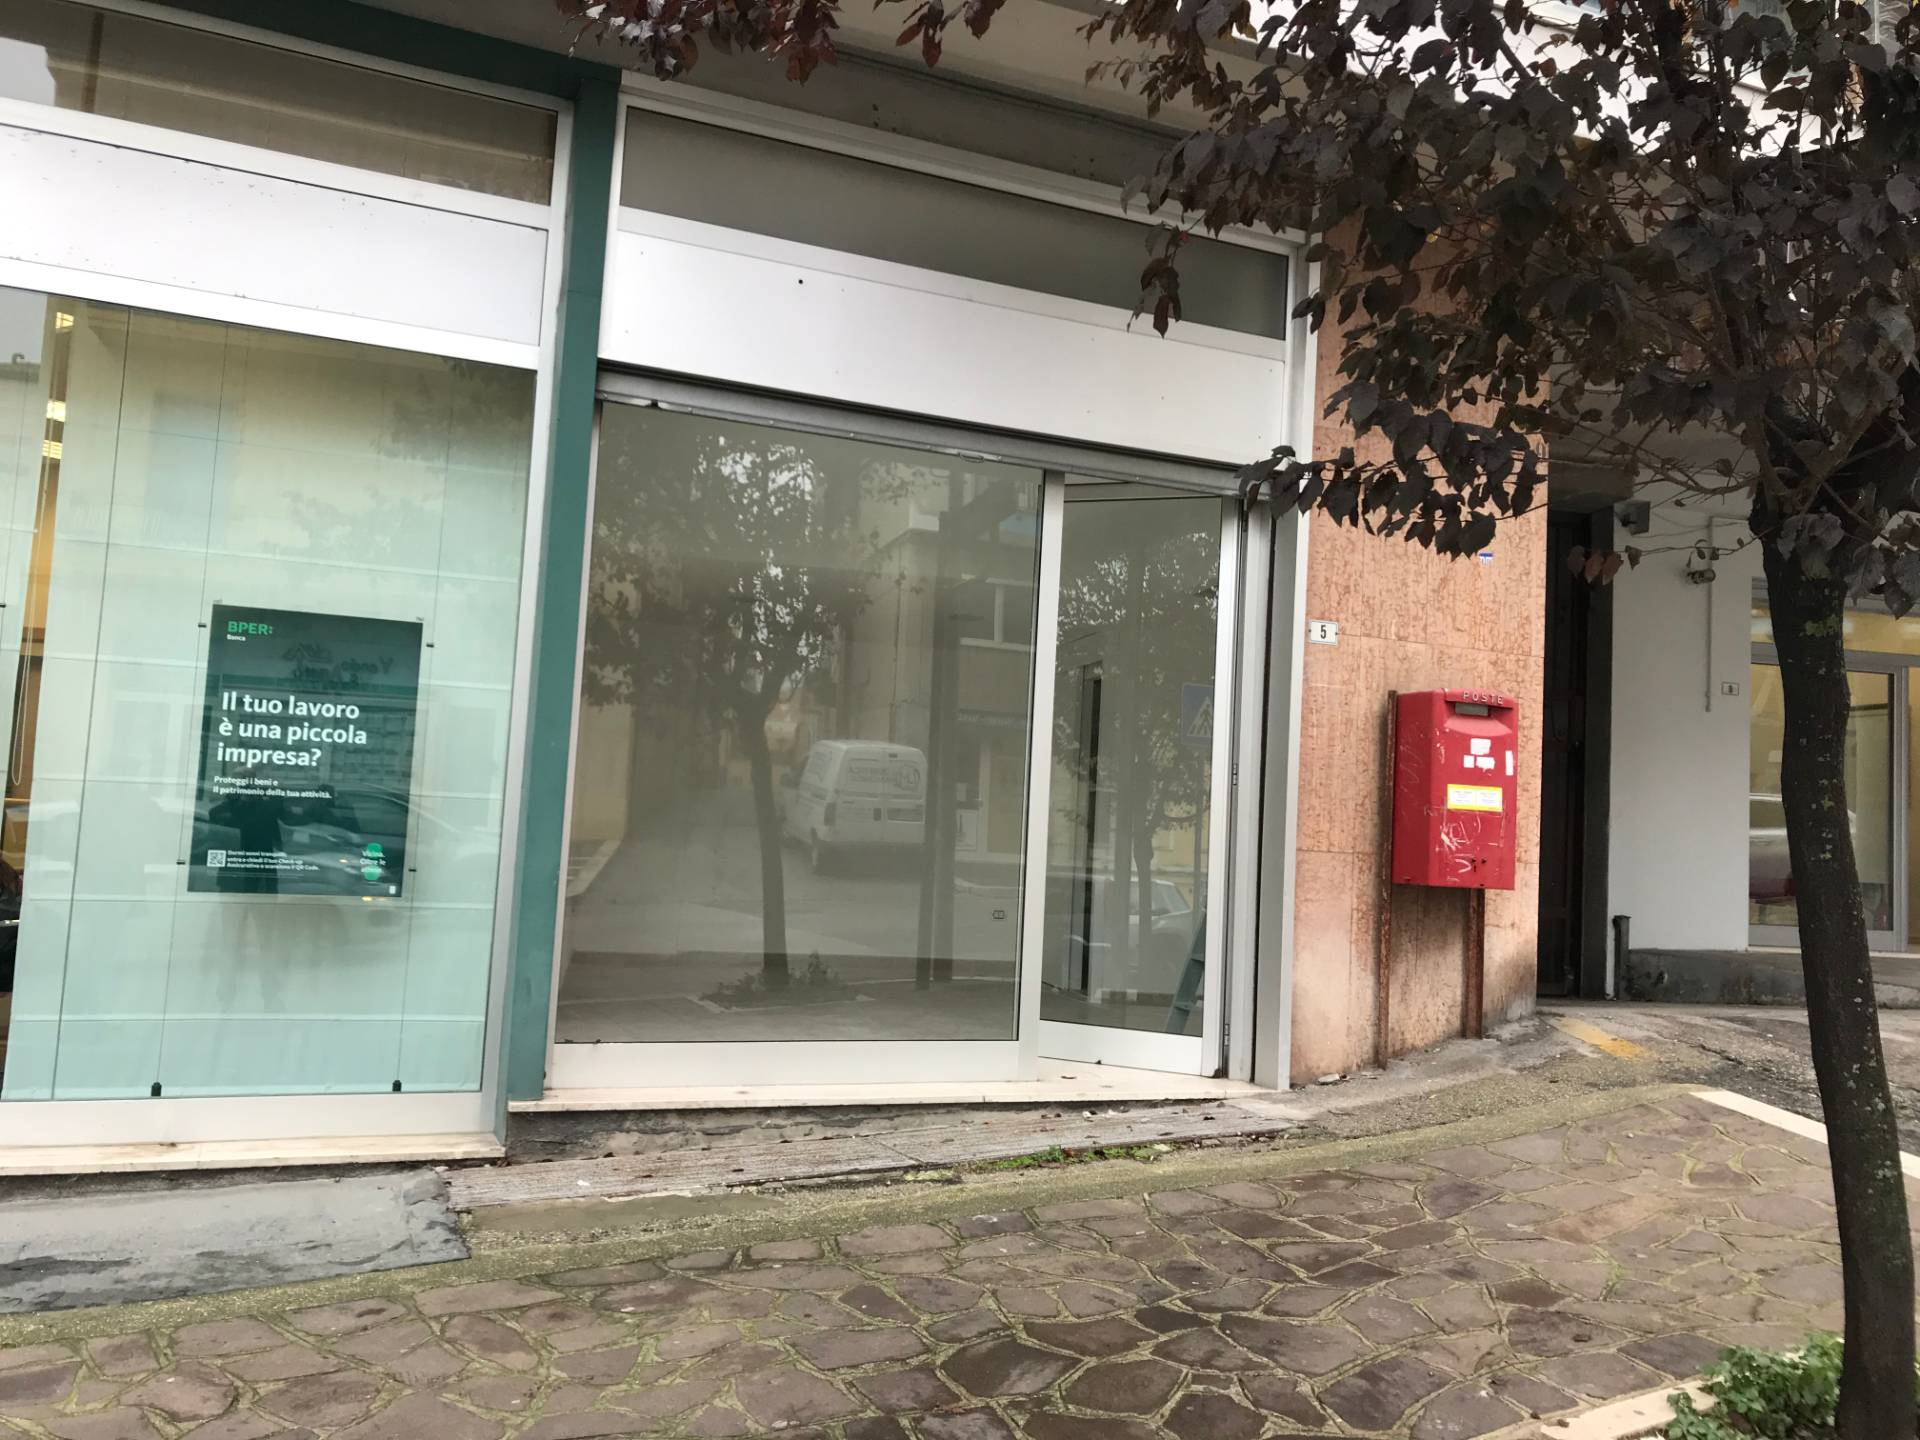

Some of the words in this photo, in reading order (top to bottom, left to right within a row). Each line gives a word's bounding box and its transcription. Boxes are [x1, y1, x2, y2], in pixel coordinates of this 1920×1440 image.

[227, 620, 273, 636] BPER:
[1320, 624, 1327, 640] 5
[222, 691, 237, 711] Il
[243, 694, 283, 714] tuo
[288, 695, 360, 719] lavoro
[1463, 690, 1504, 706] POSTE
[218, 717, 233, 736] è
[238, 722, 282, 740] una
[287, 721, 367, 745] piccola
[217, 741, 322, 769] impresa?
[214, 775, 249, 787] Proteggi
[254, 778, 272, 786] beni
[219, 786, 265, 796] patrimonio
[265, 788, 285, 797] della
[286, 789, 300, 798] tua
